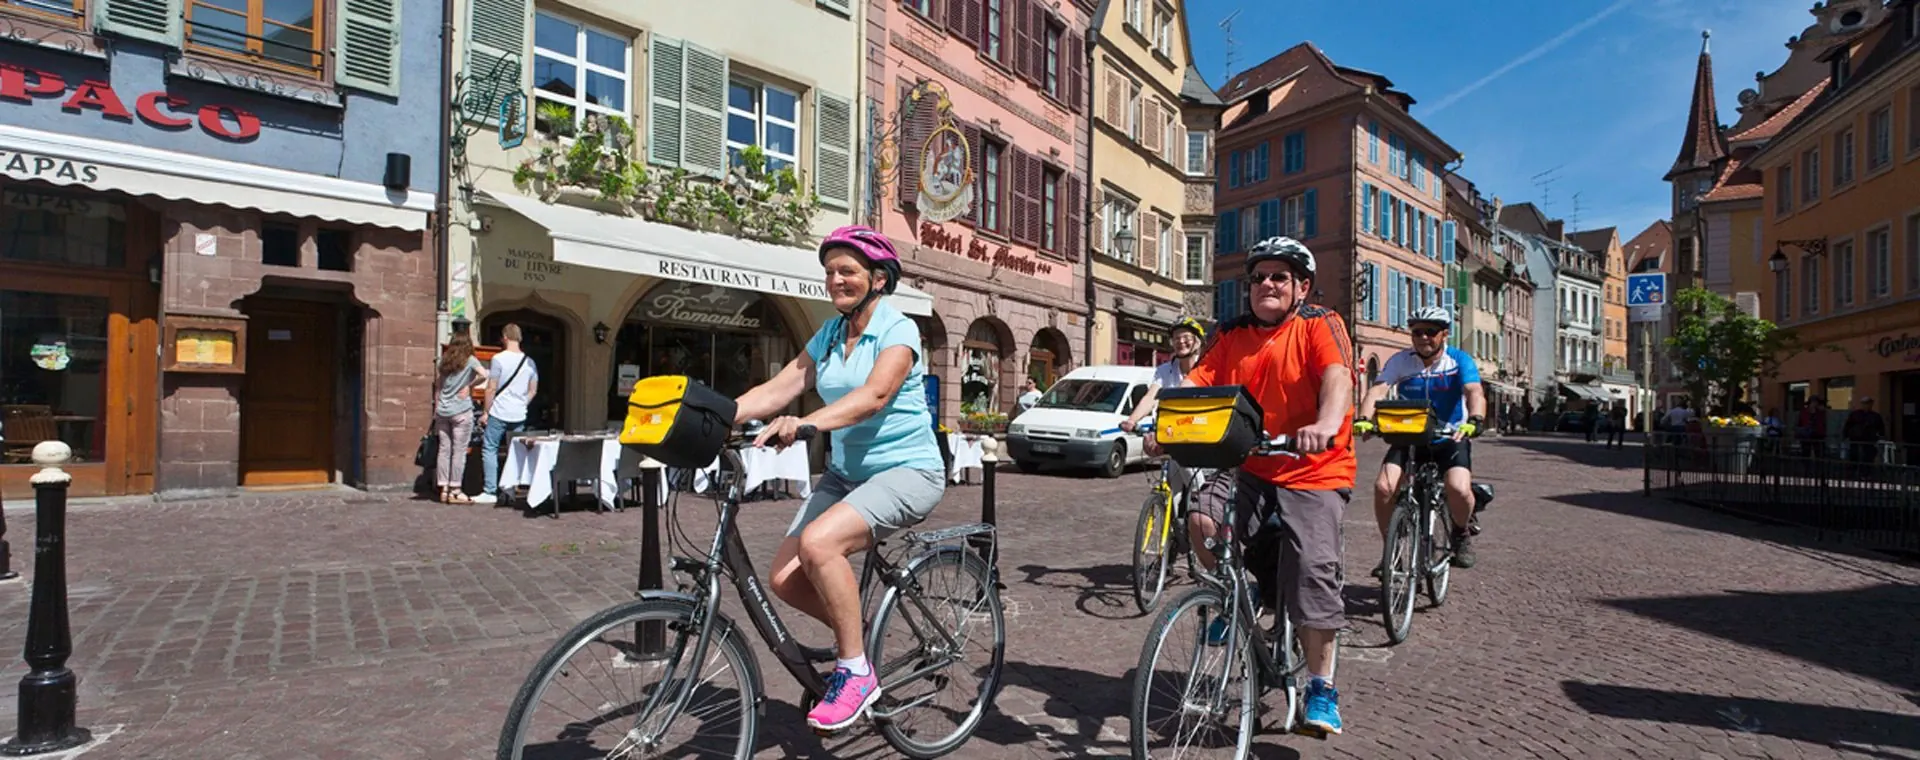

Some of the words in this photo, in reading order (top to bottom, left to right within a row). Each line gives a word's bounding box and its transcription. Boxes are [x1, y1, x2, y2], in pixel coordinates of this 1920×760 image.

[0, 63, 261, 139] PACO
[0, 151, 98, 184] APAS
[658, 259, 762, 288] RESTAURANT
[771, 277, 790, 293] LA
[992, 247, 1037, 277] Martin
[648, 294, 761, 329] Romantica
